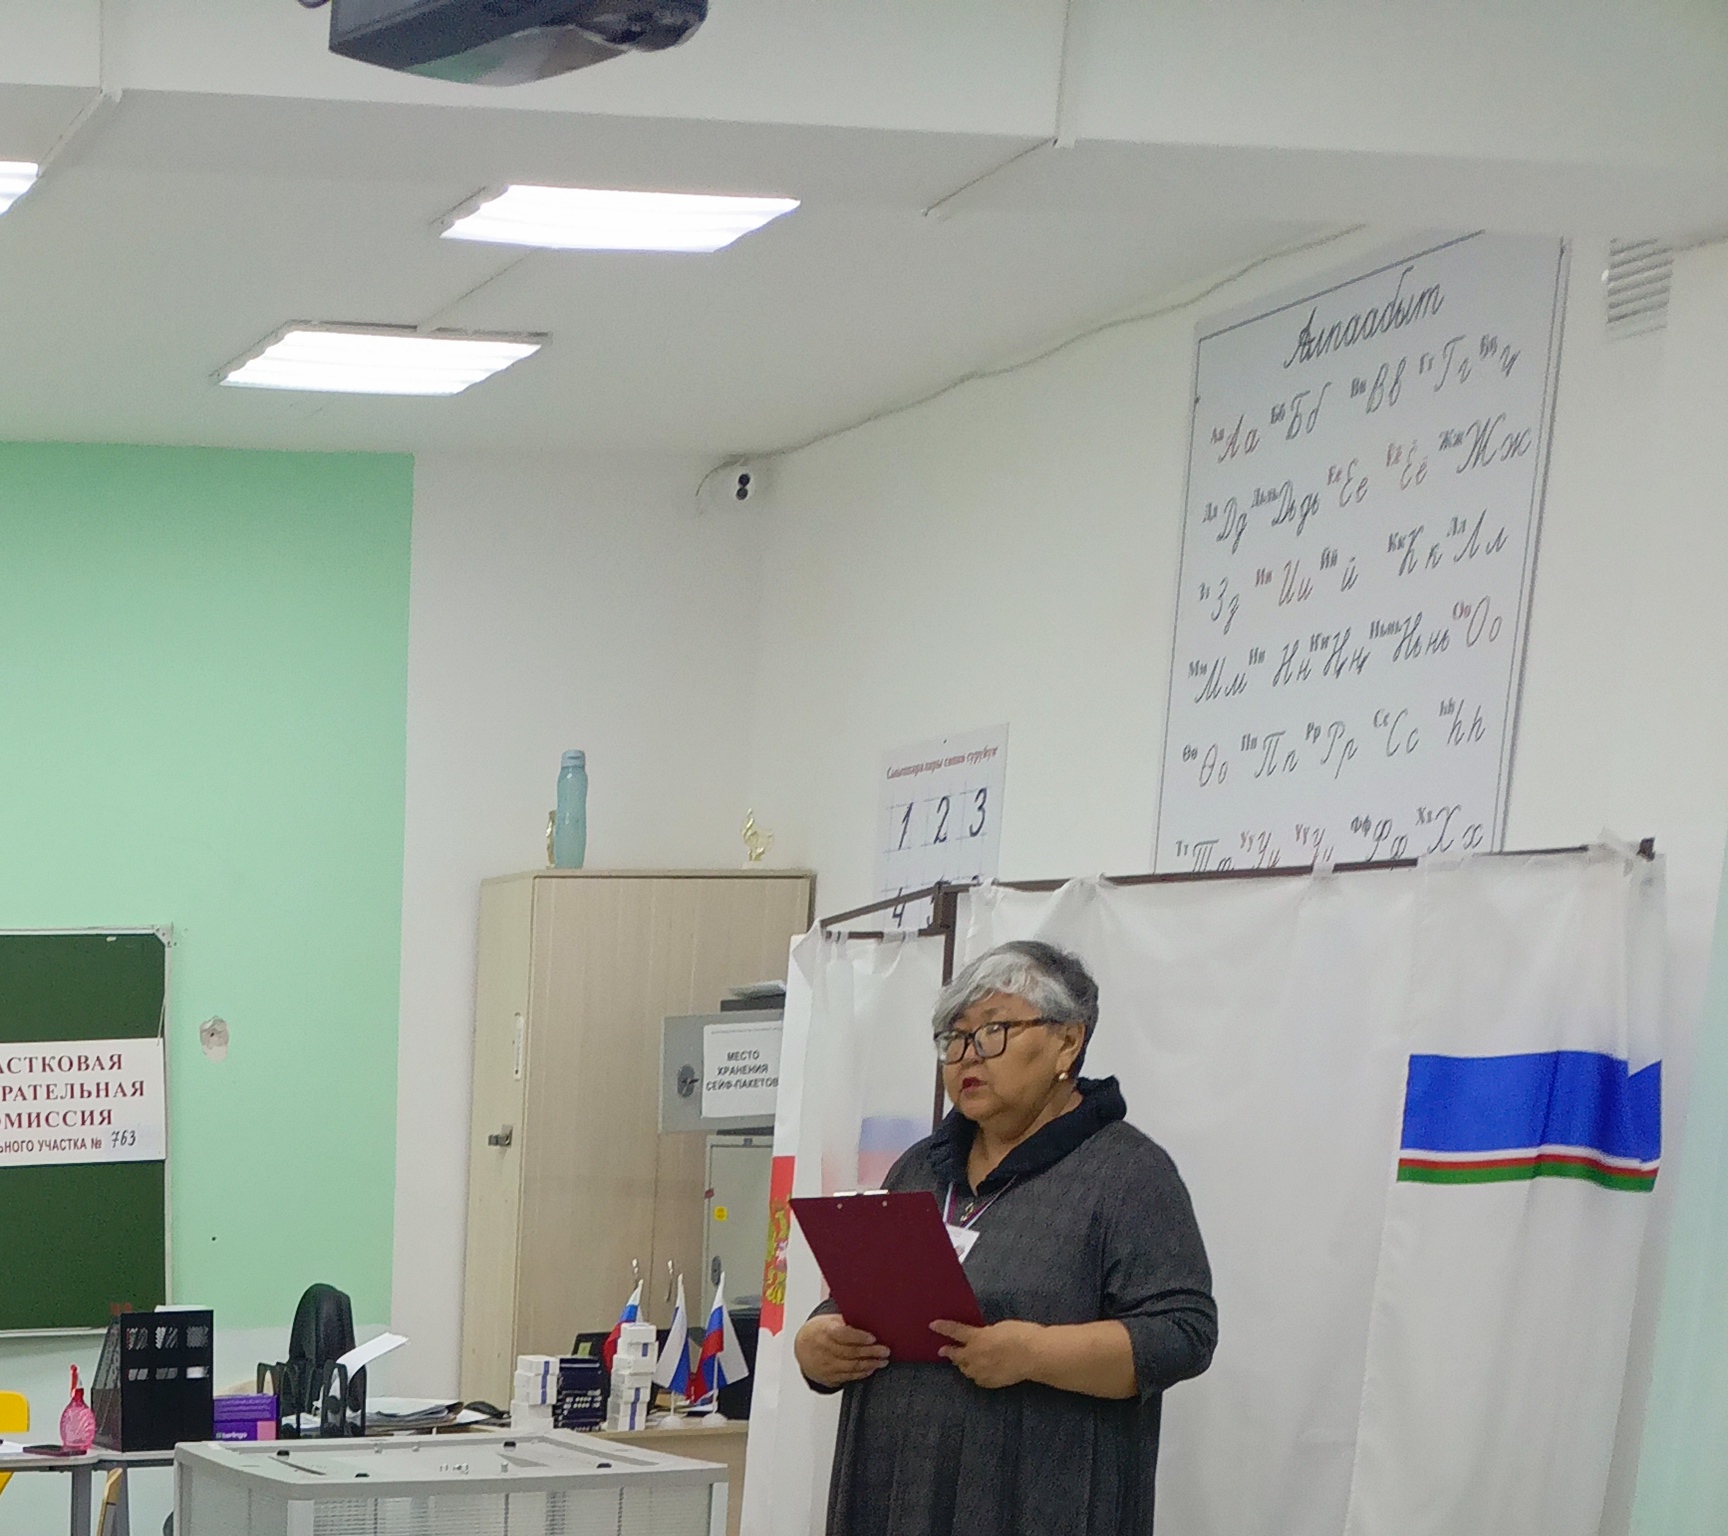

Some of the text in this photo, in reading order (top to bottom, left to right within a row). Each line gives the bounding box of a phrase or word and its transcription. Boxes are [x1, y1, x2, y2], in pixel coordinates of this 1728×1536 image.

[898, 787, 987, 850] 1 2 3
[727, 1050, 760, 1062] МЕСТО
[717, 1064, 769, 1076] ХРАНЕНИЯ
[38, 1138, 87, 1152] УЧАСТКА
[91, 1137, 102, 1149] №
[111, 1130, 136, 1148] 763
